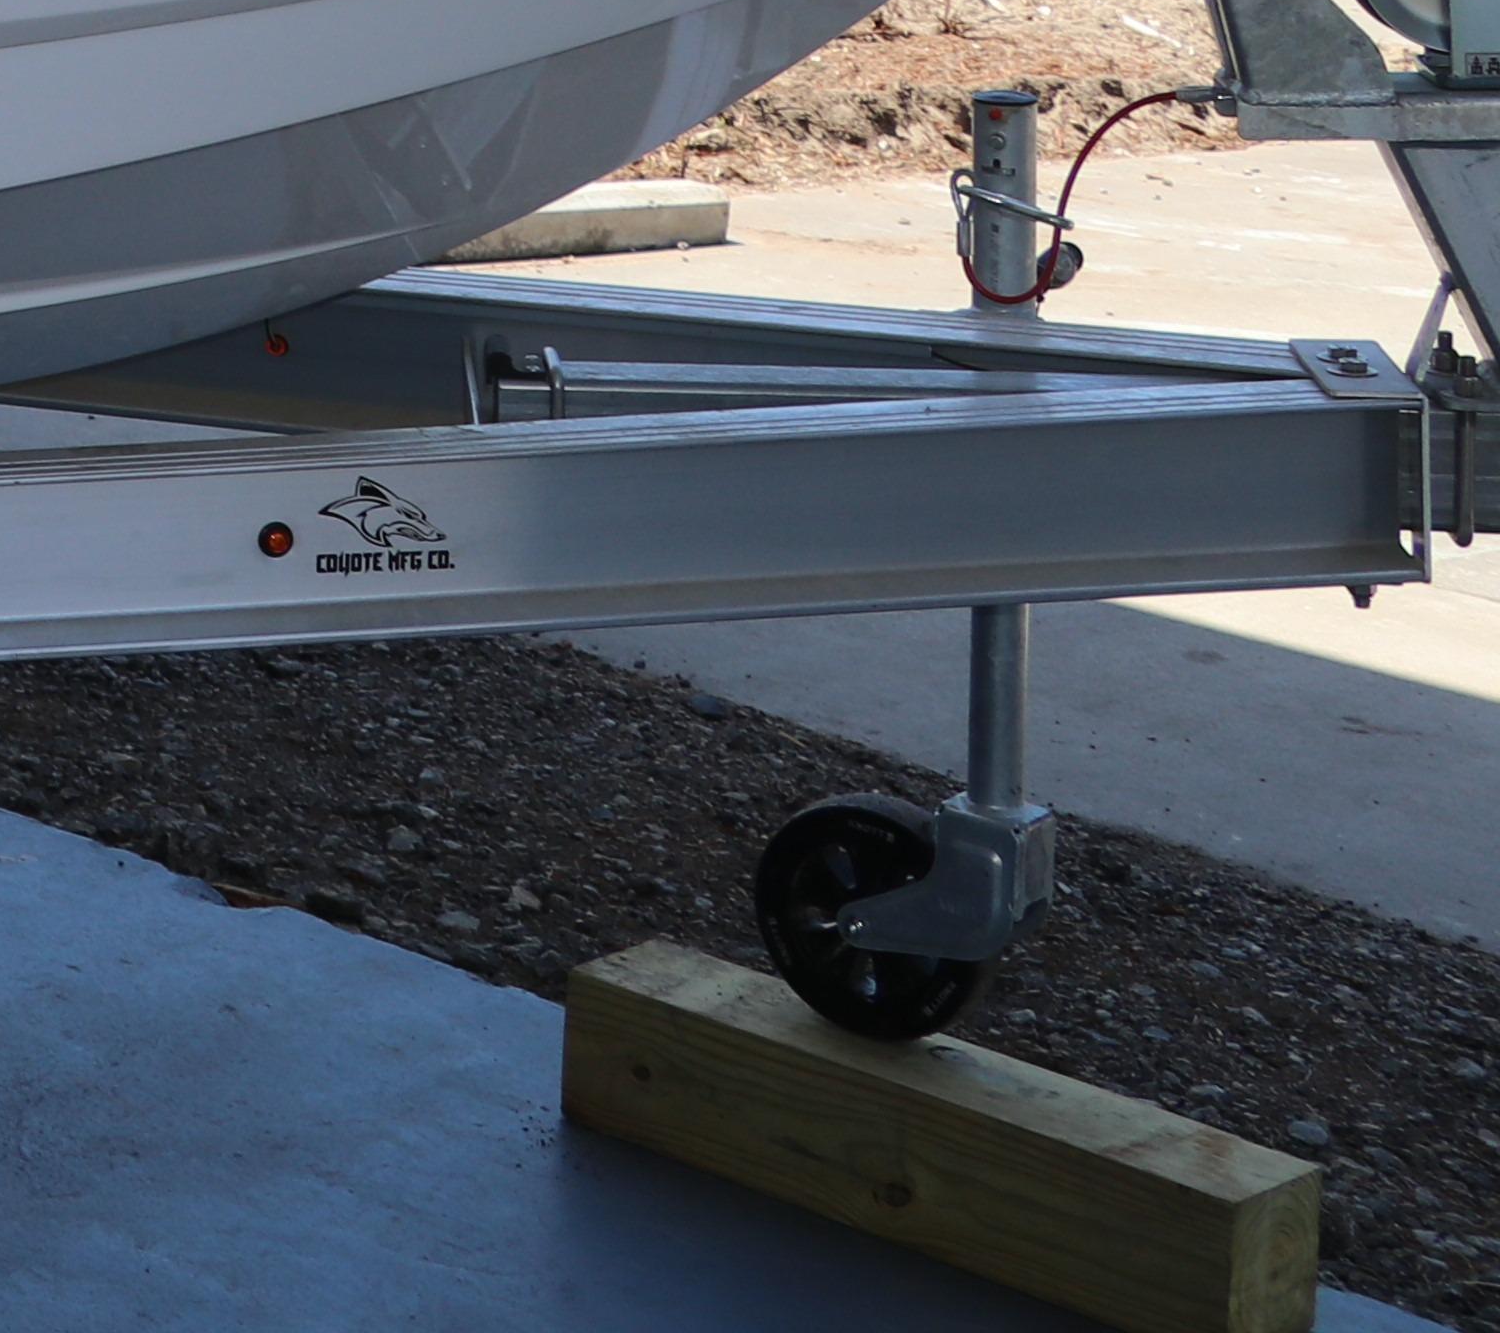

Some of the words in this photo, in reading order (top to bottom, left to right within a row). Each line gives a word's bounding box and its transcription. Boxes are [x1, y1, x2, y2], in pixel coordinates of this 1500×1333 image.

[315, 551, 384, 577] COYOTE
[387, 549, 423, 574] MFG
[427, 549, 456, 571] CO.
